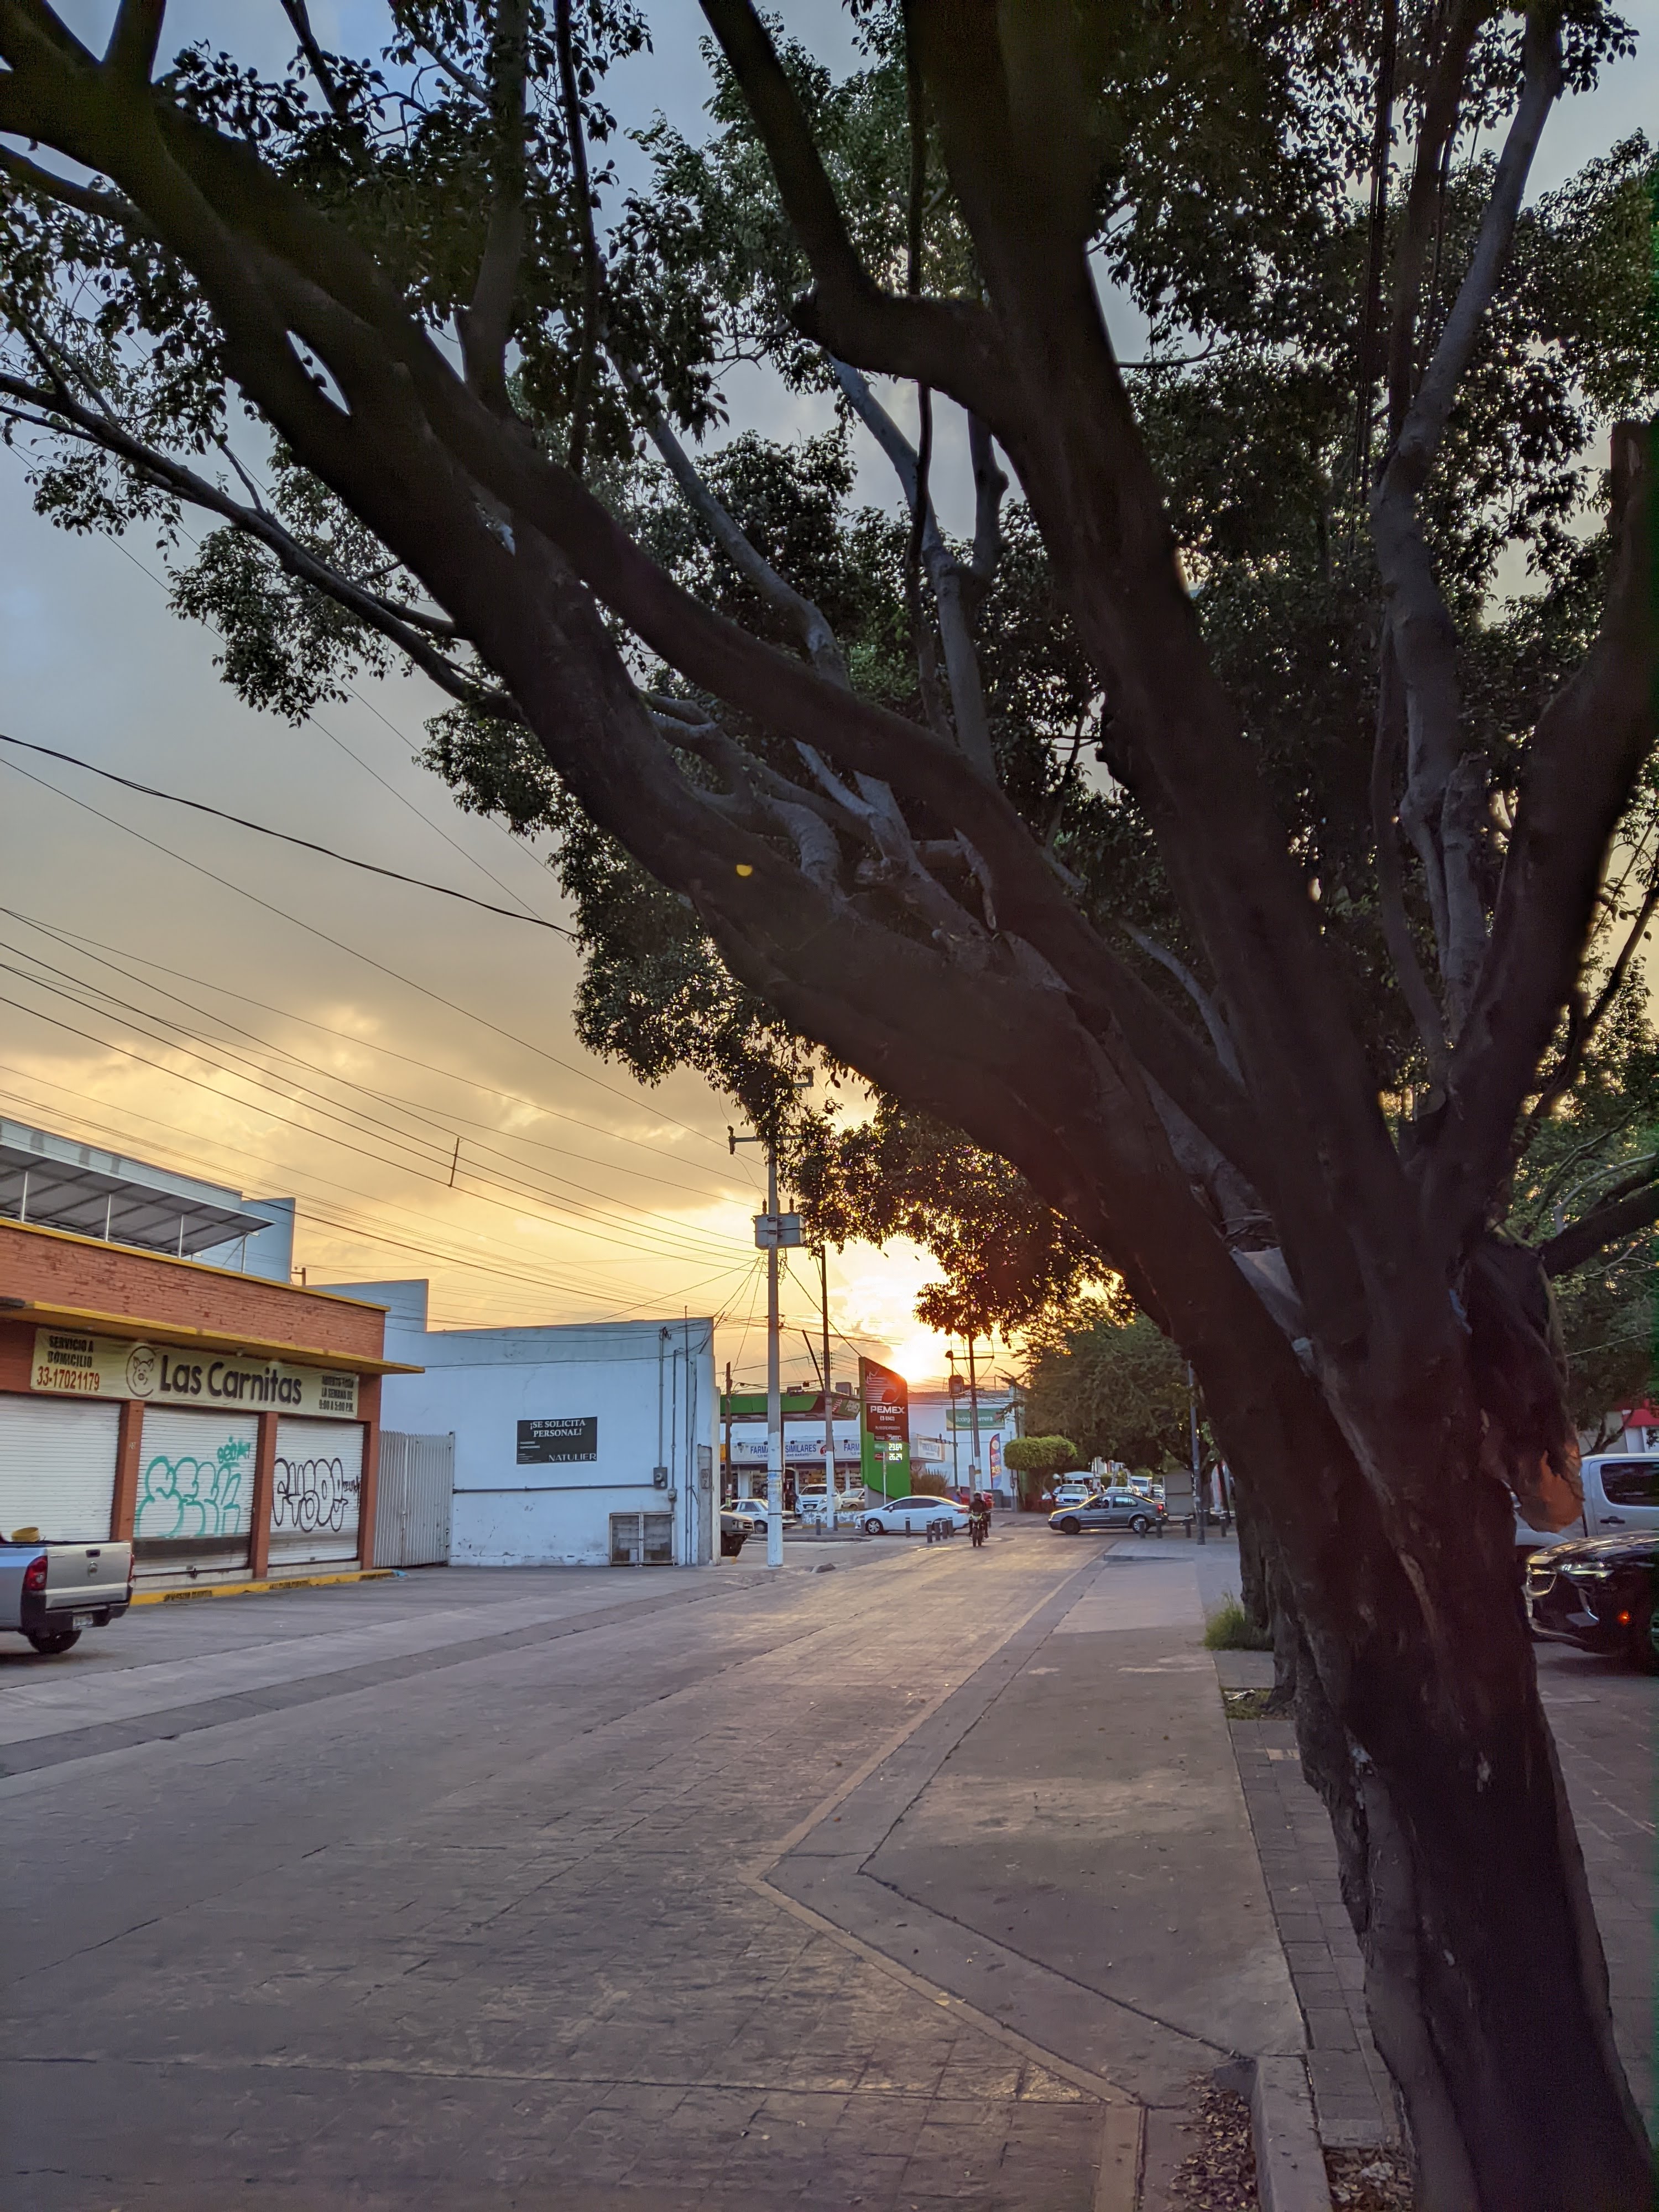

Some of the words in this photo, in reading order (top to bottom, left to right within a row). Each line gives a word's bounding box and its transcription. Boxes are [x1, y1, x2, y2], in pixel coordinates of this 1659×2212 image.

[49, 1335, 87, 1352] SERVICIO
[88, 1340, 93, 1353] A
[48, 1350, 92, 1368] DOMICILIO
[36, 1366, 100, 1391] 33-17021179
[160, 1355, 202, 1395] Las
[208, 1361, 302, 1405] Carnitas
[870, 1406, 905, 1414] PEMEX
[530, 1421, 543, 1430] ¡SE
[545, 1419, 586, 1428] SOLICITA
[533, 1428, 582, 1438] PERSONAL!
[785, 1444, 816, 1453] SIMILARES
[549, 1453, 597, 1462] NATULIER
